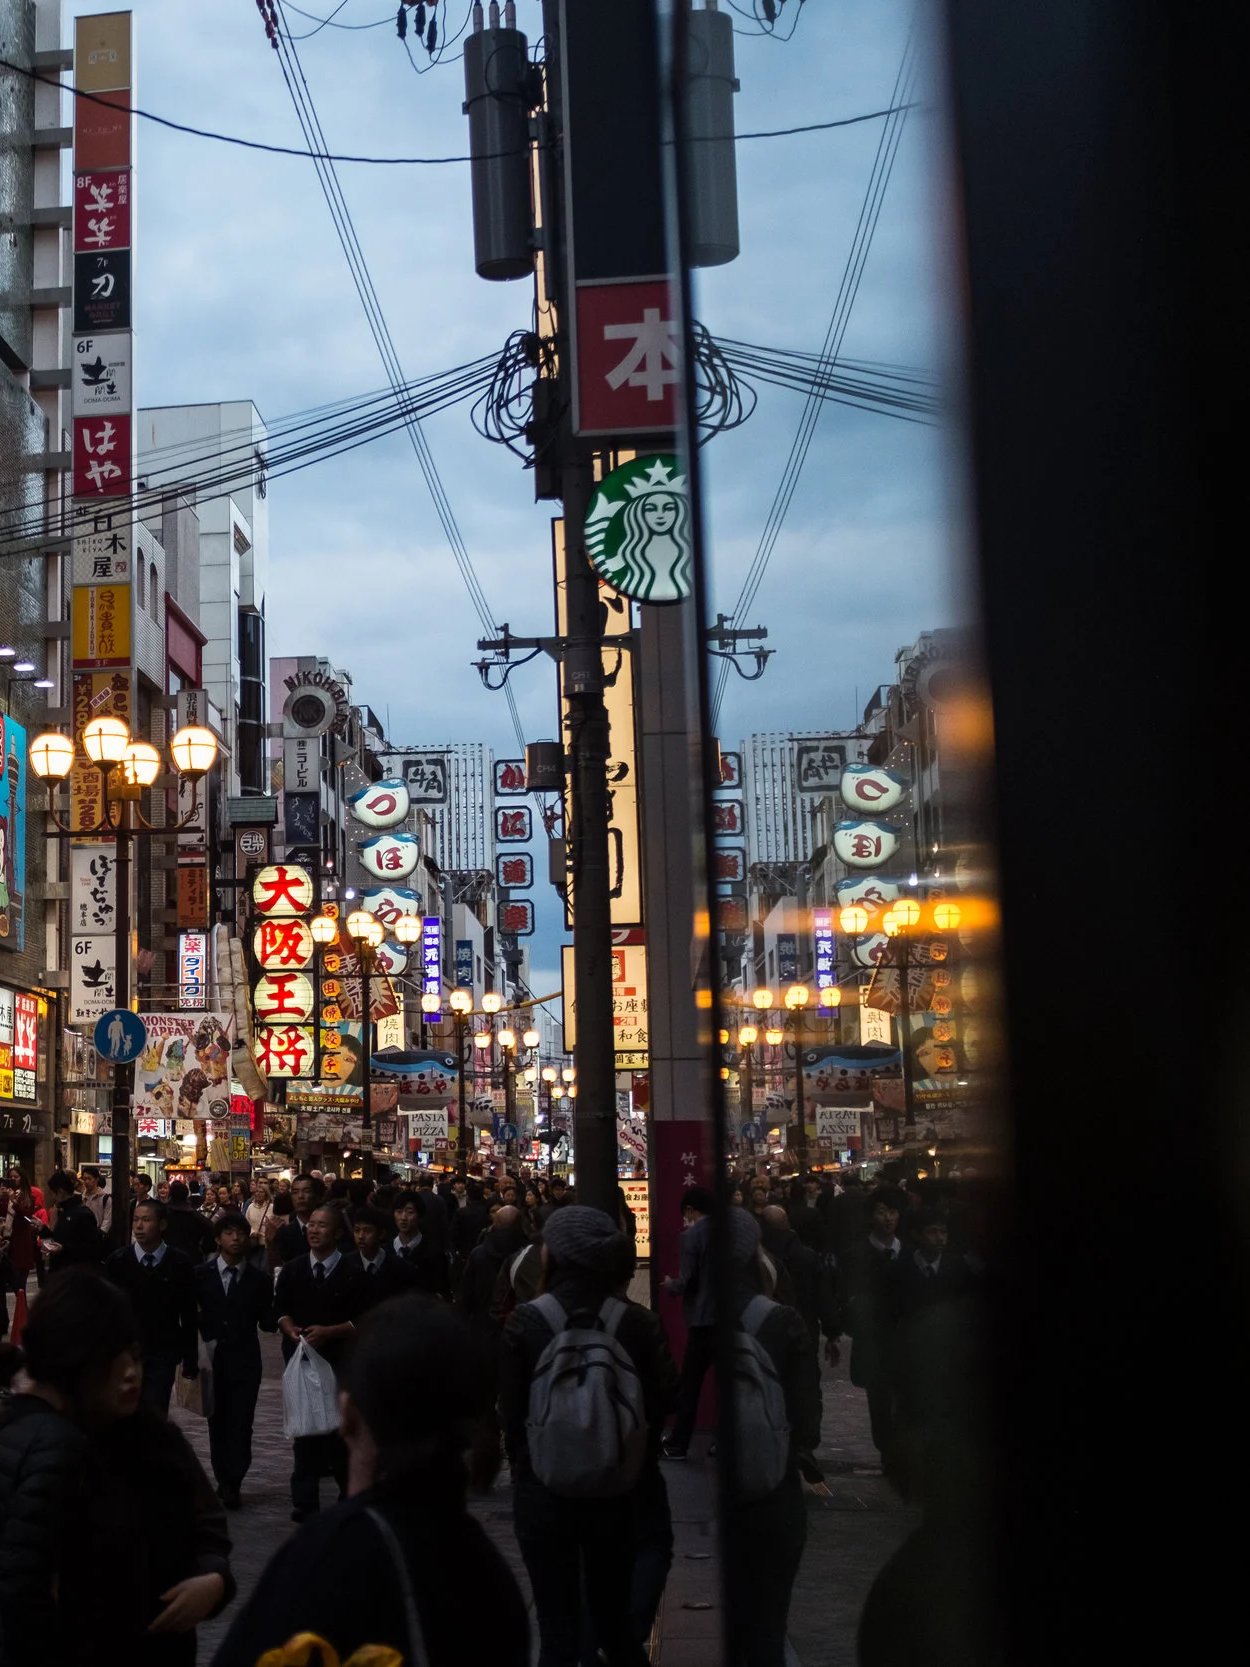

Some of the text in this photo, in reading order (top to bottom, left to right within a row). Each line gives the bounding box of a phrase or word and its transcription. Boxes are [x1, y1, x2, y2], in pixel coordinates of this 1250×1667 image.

[77, 177, 92, 188] 8F
[77, 341, 93, 353] 6F
[75, 942, 92, 955] 6F
[256, 866, 310, 1079] 大阪王将
[84, 998, 115, 1007] DOMA-DOM
[618, 1028, 648, 1044] 和食
[411, 1113, 446, 1122] PASTA
[412, 1127, 446, 1137] PIZZA
[680, 1151, 699, 1187] 竹本
